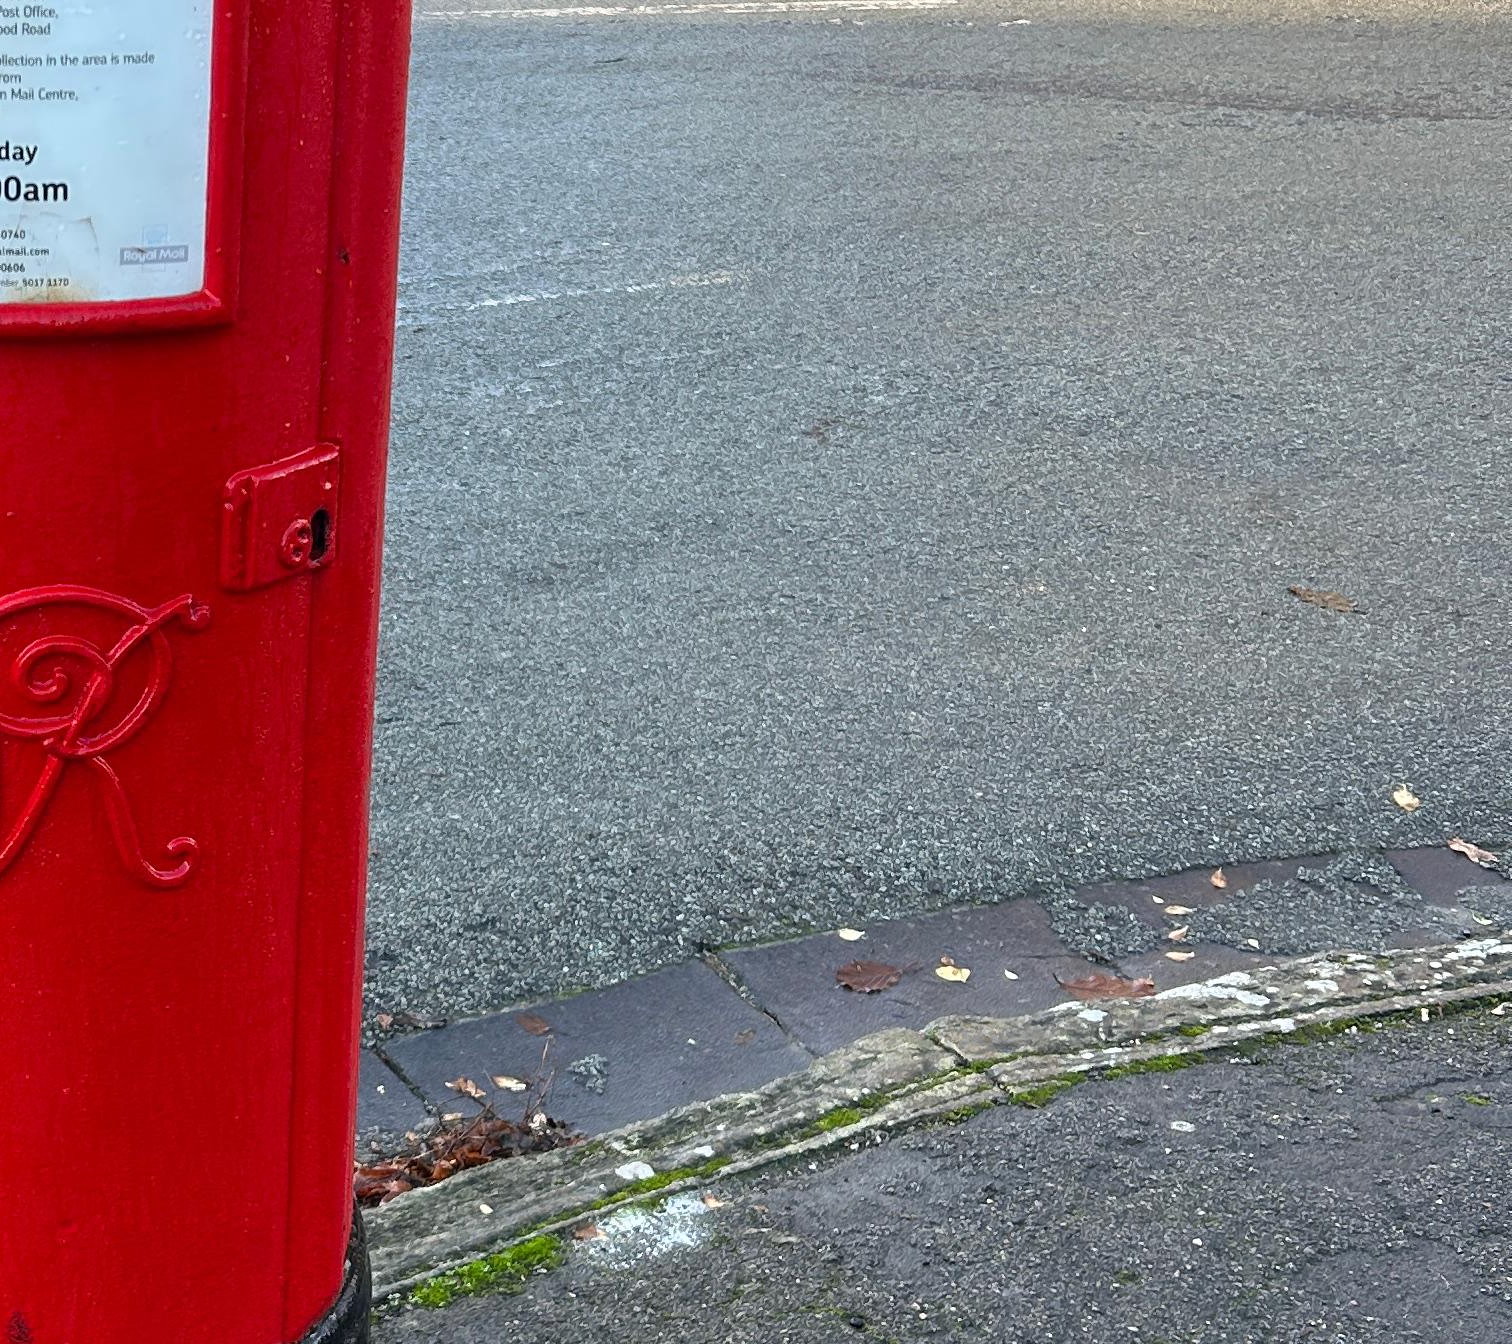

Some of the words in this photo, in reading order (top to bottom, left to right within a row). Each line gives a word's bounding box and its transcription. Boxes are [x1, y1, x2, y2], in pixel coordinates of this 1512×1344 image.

[23, 5, 58, 20] Office,
[21, 22, 51, 36] Road
[46, 54, 57, 66] in
[60, 53, 79, 66] the
[82, 55, 107, 66] area
[110, 52, 120, 65] is
[124, 51, 155, 65] made
[11, 88, 34, 101] Mail
[38, 88, 79, 102] Centre,
[124, 250, 157, 263] Royal
[159, 247, 185, 260] Mail
